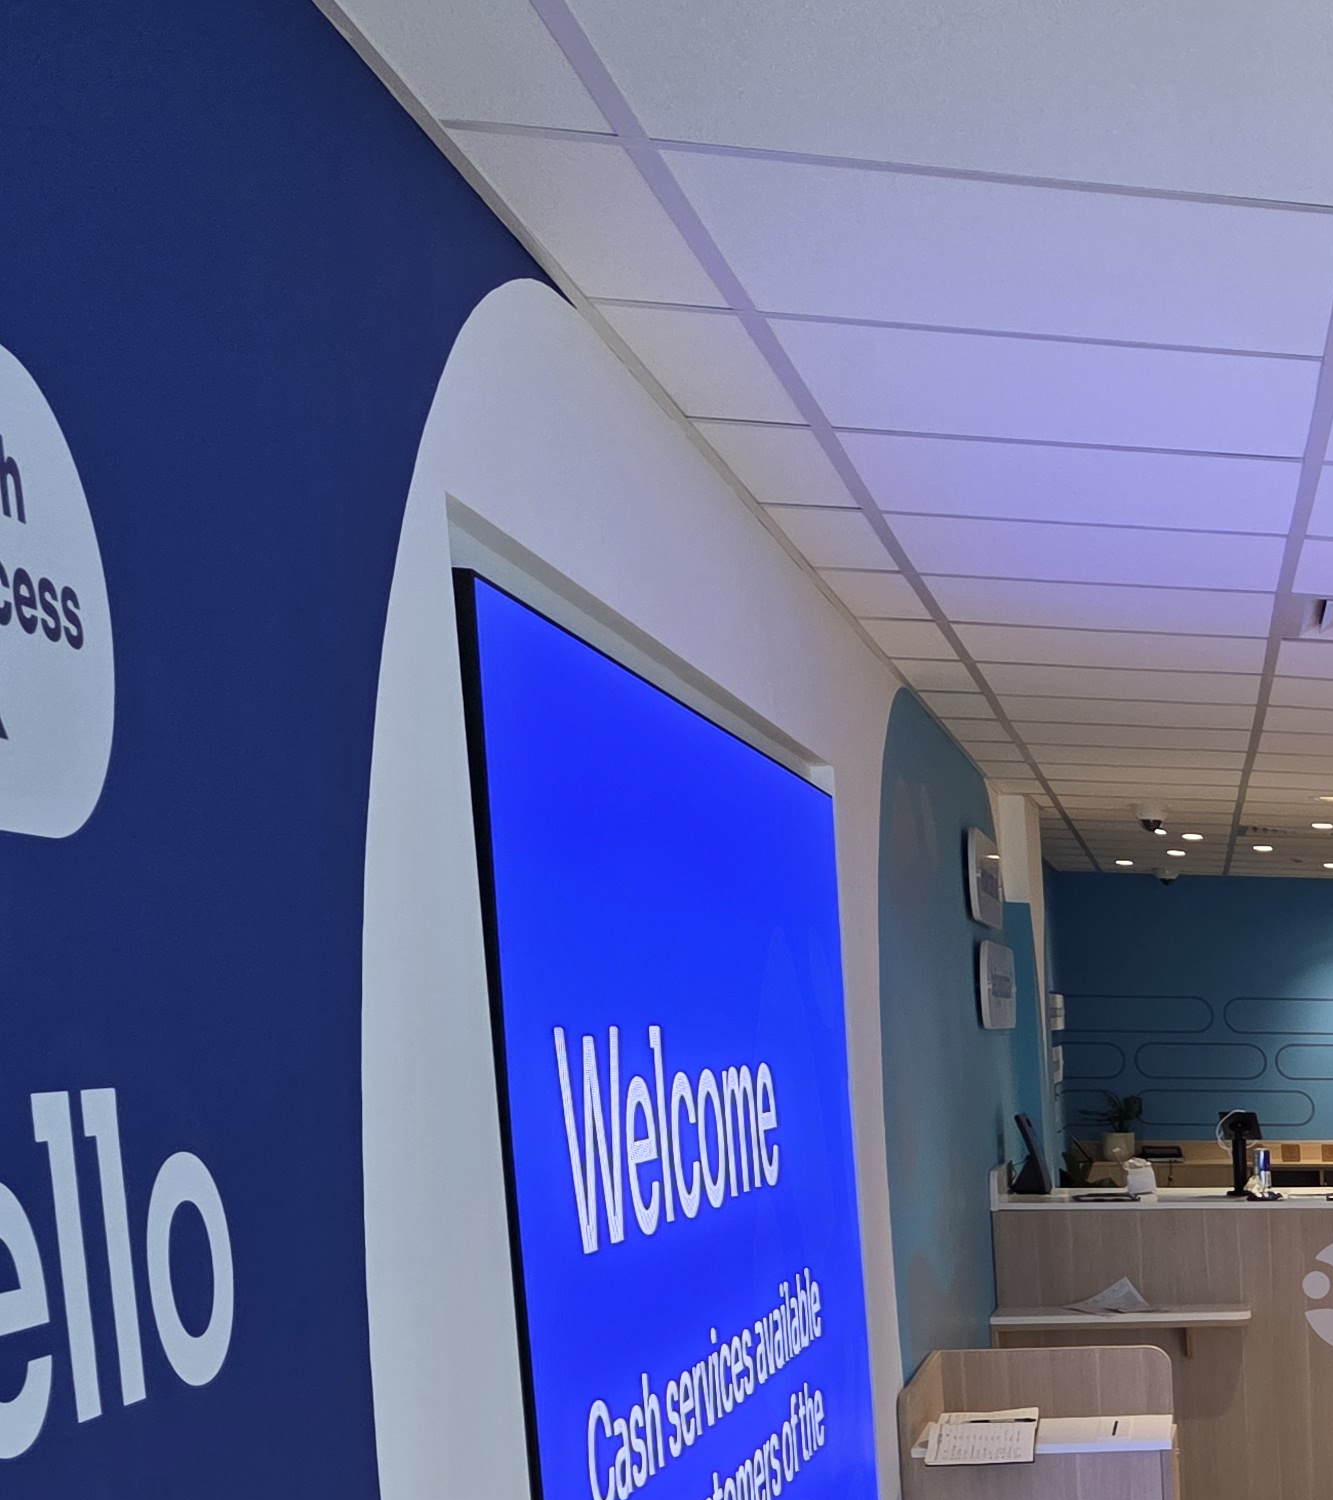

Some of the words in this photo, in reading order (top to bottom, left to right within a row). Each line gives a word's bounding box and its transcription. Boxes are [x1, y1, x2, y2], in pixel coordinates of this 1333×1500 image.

[554, 1026, 778, 1254] Welcome
[666, 1327, 755, 1457] services
[755, 1267, 822, 1384] available
[782, 1393, 799, 1482] of
[798, 1382, 825, 1461] the
